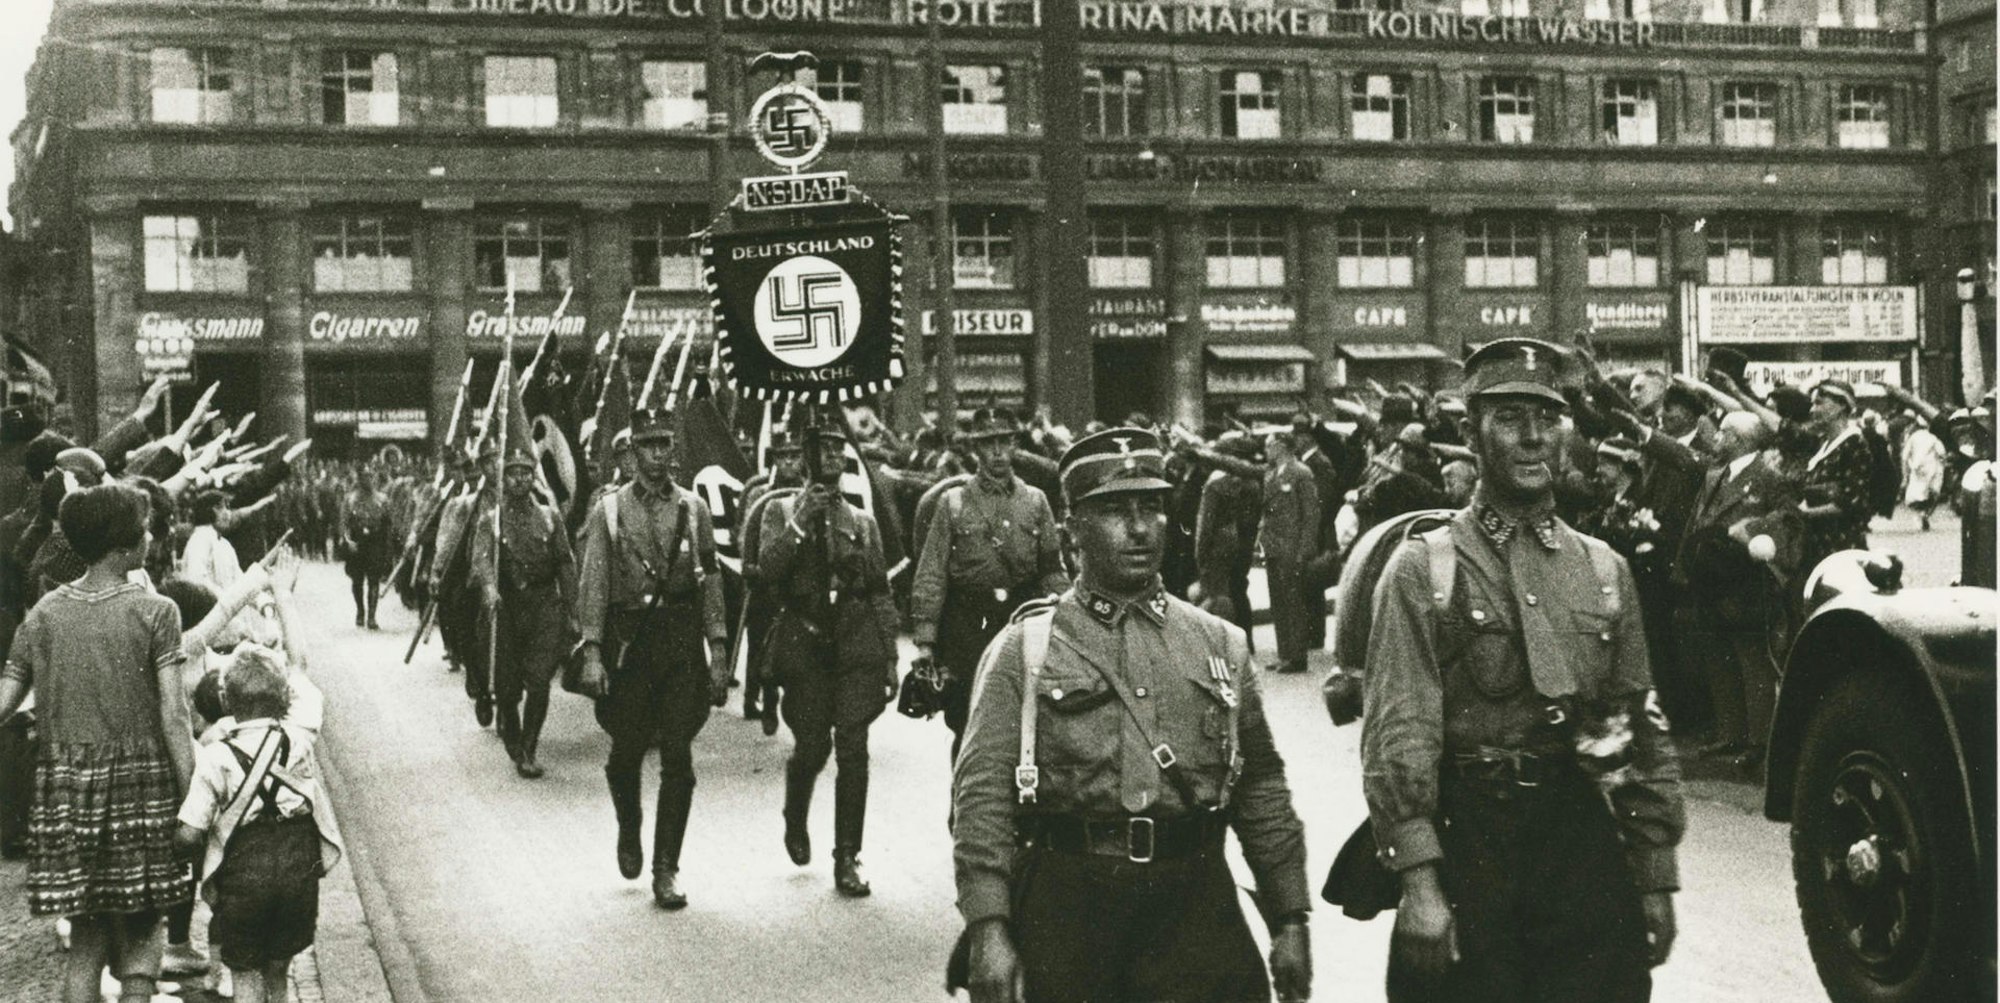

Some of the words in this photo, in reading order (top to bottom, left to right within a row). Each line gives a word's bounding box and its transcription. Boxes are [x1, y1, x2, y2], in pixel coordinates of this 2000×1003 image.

[667, 0, 846, 23] CLOGNE
[731, 235, 875, 261] DEUTSCHLAND
[309, 311, 420, 342] Cigarren
[929, 313, 1025, 332] ISEUR
[769, 364, 856, 383] ERWACHE
